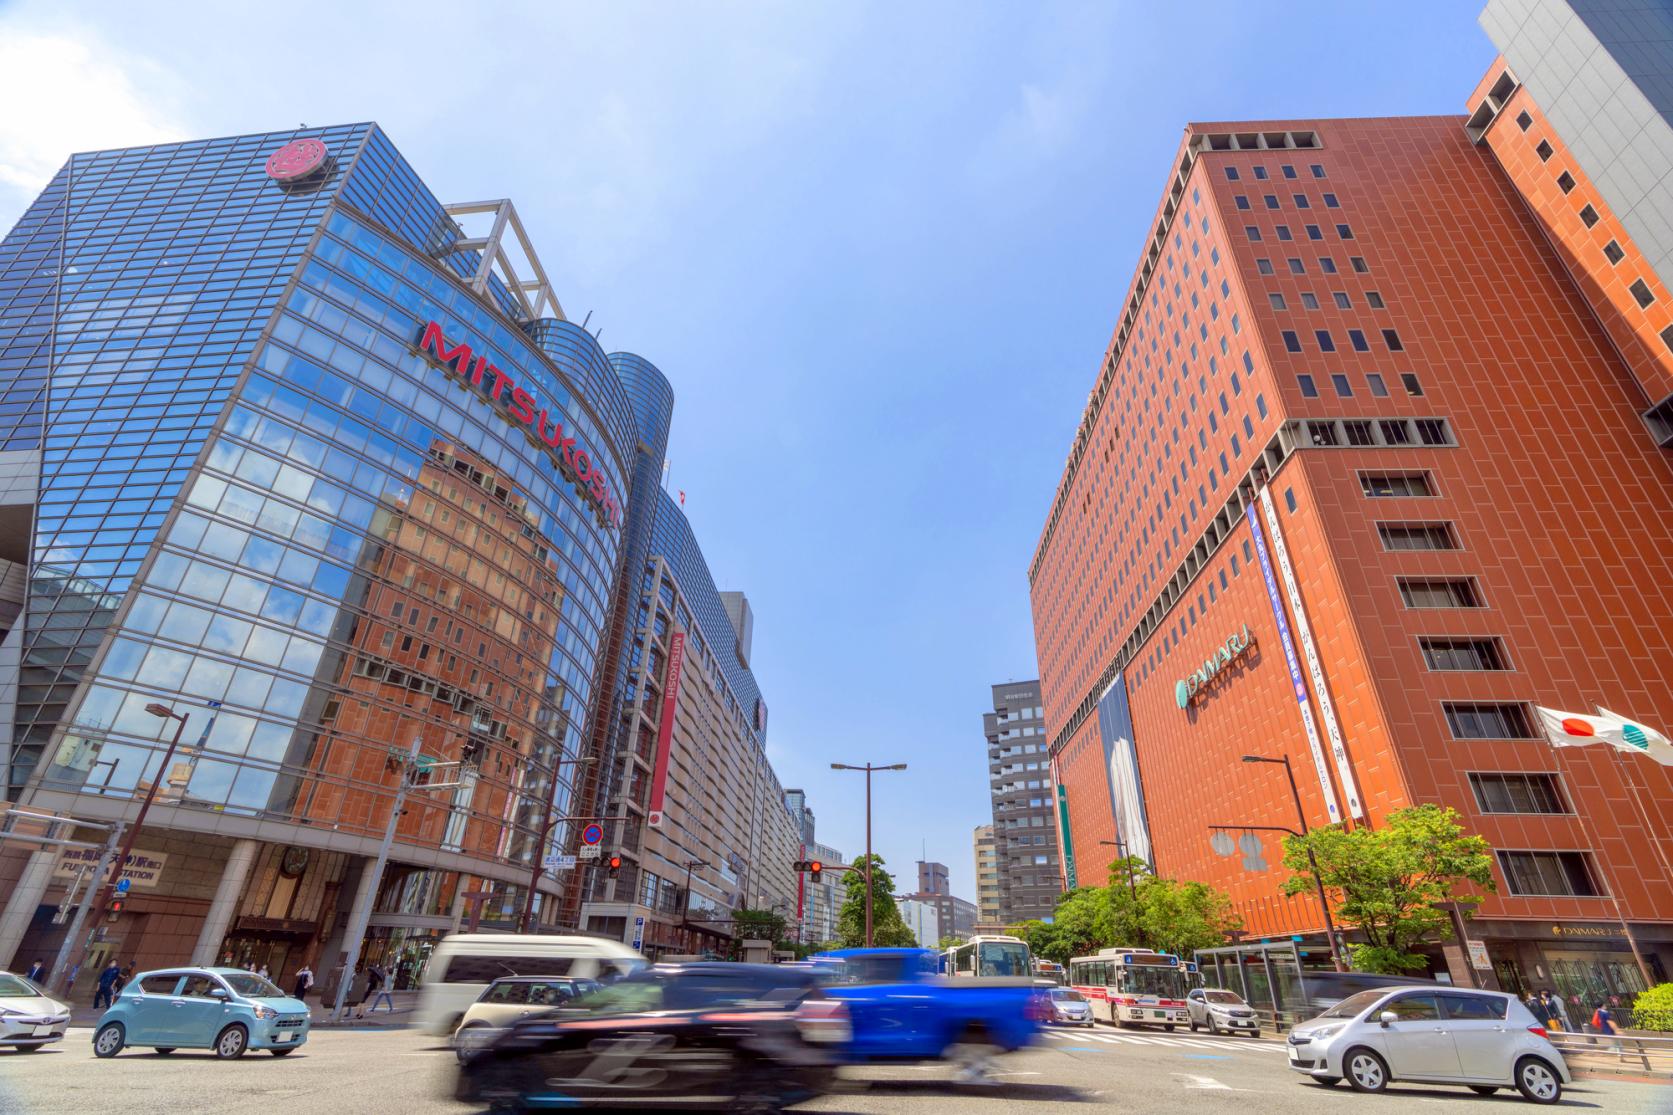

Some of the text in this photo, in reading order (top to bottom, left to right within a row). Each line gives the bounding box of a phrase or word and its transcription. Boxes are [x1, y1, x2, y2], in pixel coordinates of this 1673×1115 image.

[420, 320, 620, 528] MITSUKOSHI
[666, 636, 683, 698] MITSUKOSHI
[1186, 623, 1249, 698] DAIMARU
[119, 868, 154, 880] TATION
